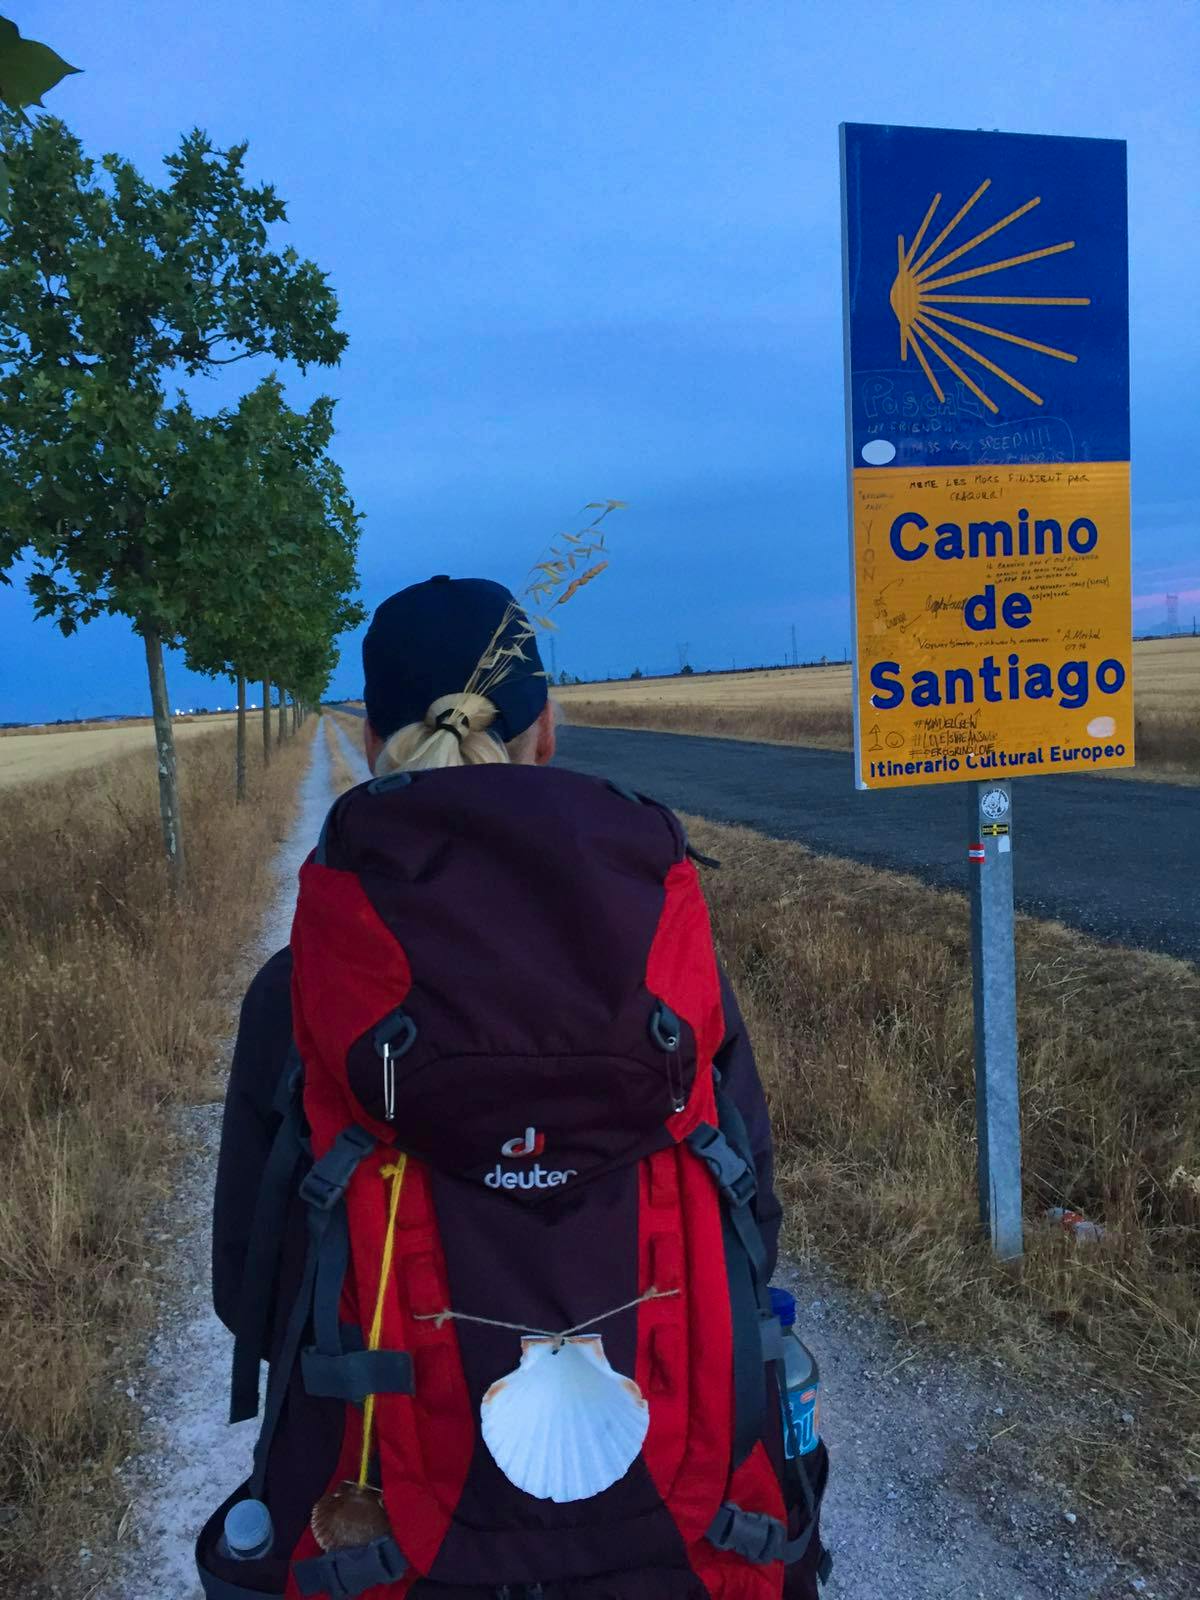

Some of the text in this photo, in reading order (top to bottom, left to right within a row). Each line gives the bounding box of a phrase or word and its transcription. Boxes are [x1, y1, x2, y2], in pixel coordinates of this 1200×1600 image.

[890, 508, 1098, 561] Camino
[964, 584, 1032, 631] de
[870, 653, 1125, 709] Santiago
[870, 743, 1125, 777] Itinerario Cultural Europeo
[484, 1163, 578, 1189] deuter
